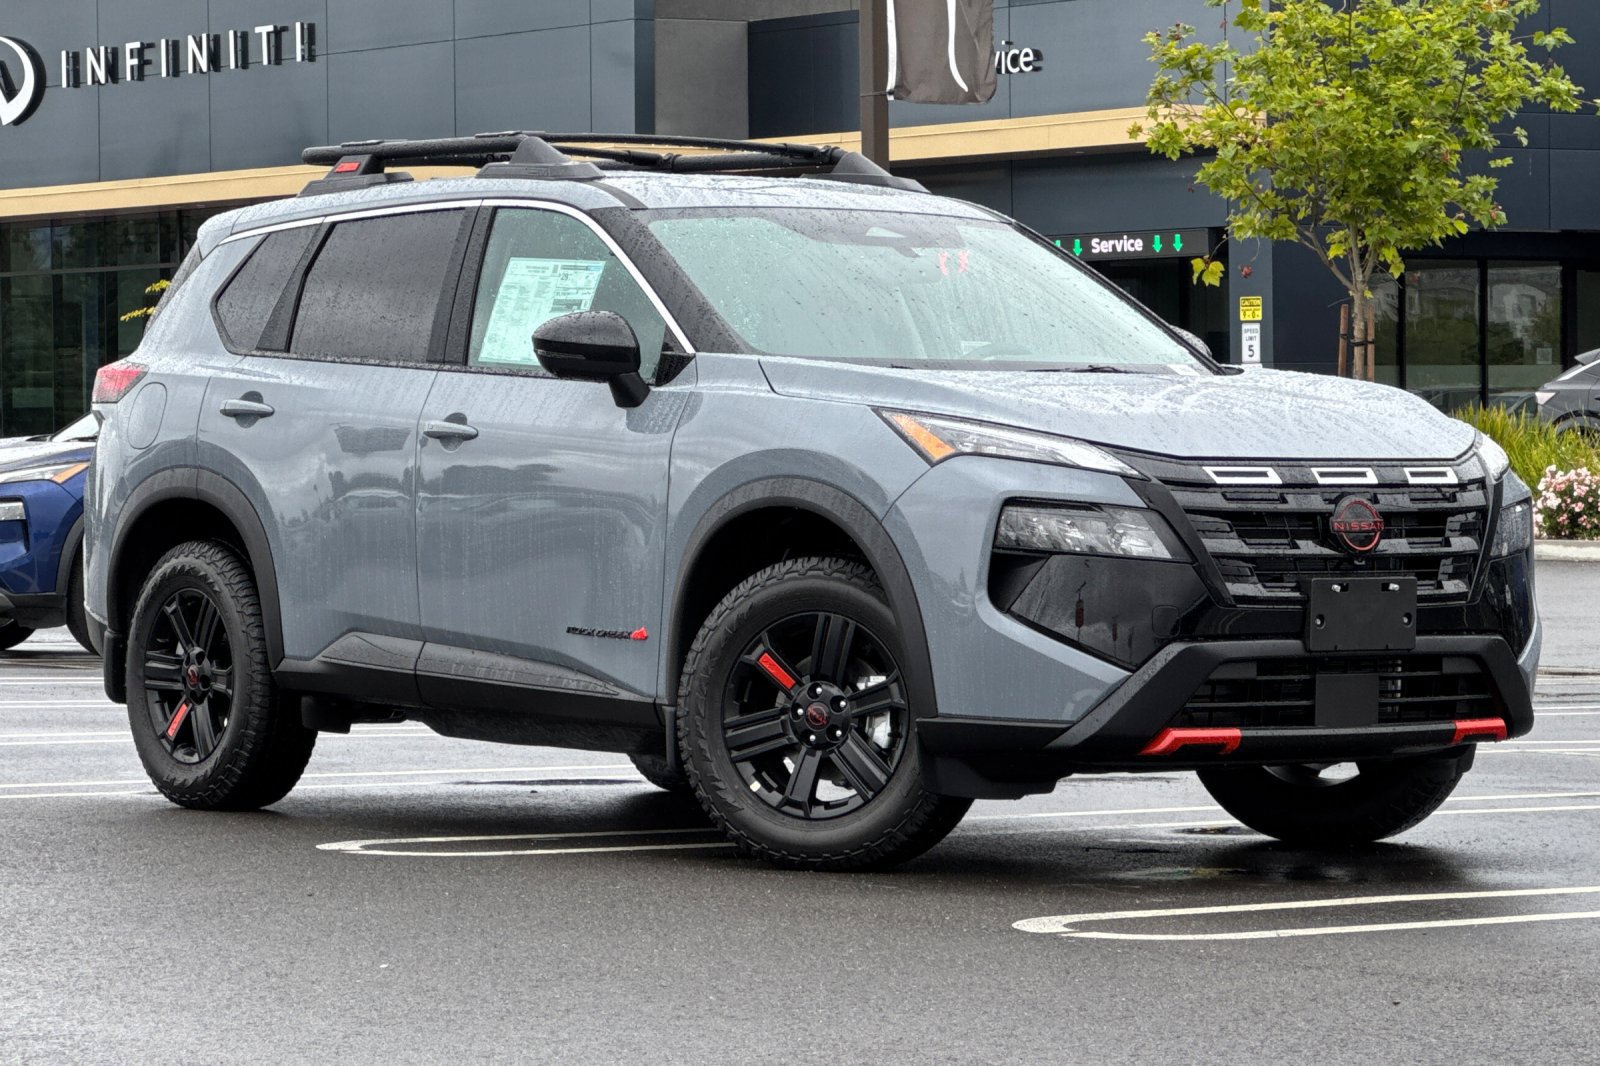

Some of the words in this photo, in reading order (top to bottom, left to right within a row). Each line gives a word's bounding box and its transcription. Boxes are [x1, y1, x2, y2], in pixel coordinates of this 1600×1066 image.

[61, 22, 305, 88] INFINITI
[1091, 234, 1143, 253] Service
[1248, 344, 1255, 358] 5
[1333, 521, 1384, 530] NISSAN
